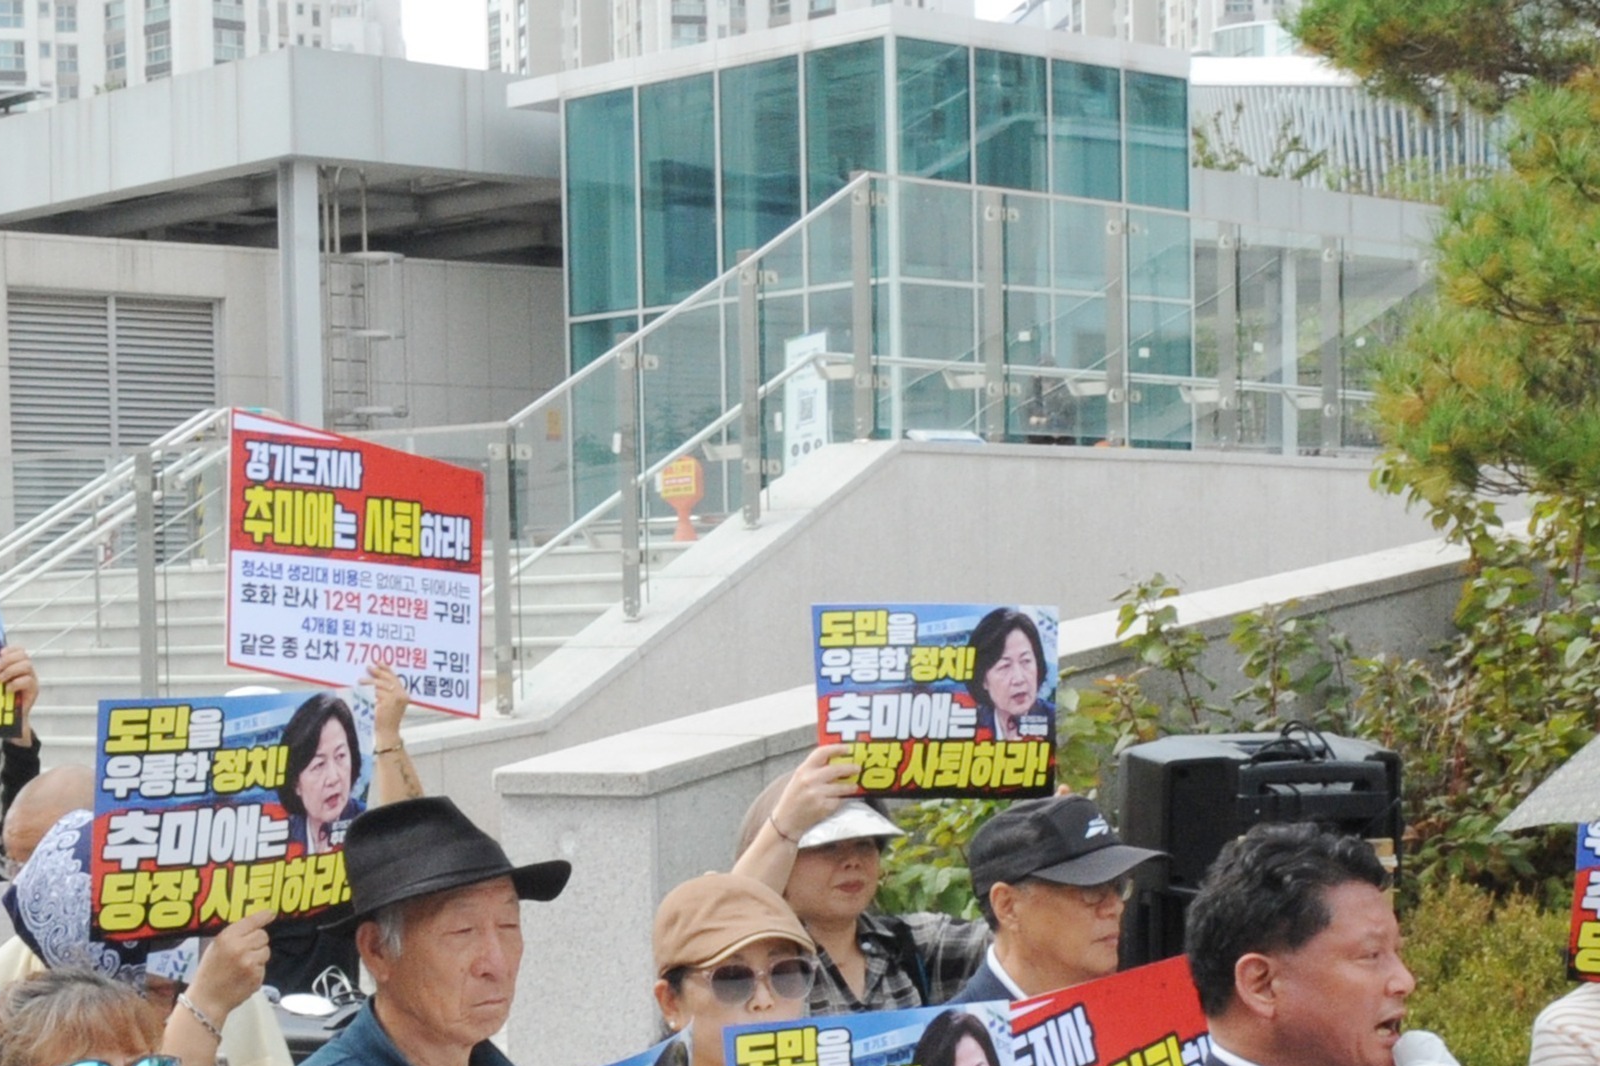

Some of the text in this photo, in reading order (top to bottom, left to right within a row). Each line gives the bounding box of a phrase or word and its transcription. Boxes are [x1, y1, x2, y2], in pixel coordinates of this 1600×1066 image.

[244, 440, 363, 490] 경기도지사
[243, 485, 471, 561] 추미애는 사퇴하라!
[240, 582, 471, 625] 호화 관사 12억 2천만원 구입!
[241, 559, 284, 581] 청소년
[287, 563, 329, 586] 생리대
[332, 568, 373, 588] 비용은
[420, 577, 471, 600] 뒤에서는
[301, 616, 416, 643] 4개월 된 차 버리고
[818, 608, 918, 648] 도민을
[239, 632, 470, 674] 같은 종 신차 7,700만원 구입!
[820, 645, 977, 684] 우롱한 정치!
[104, 704, 224, 754] 도민을
[826, 691, 978, 742] 추미애는
[102, 744, 290, 800] 우롱한 정치!
[901, 740, 1051, 789] 사퇴하라!
[101, 803, 290, 871] 추미애는
[98, 868, 201, 932] 당장
